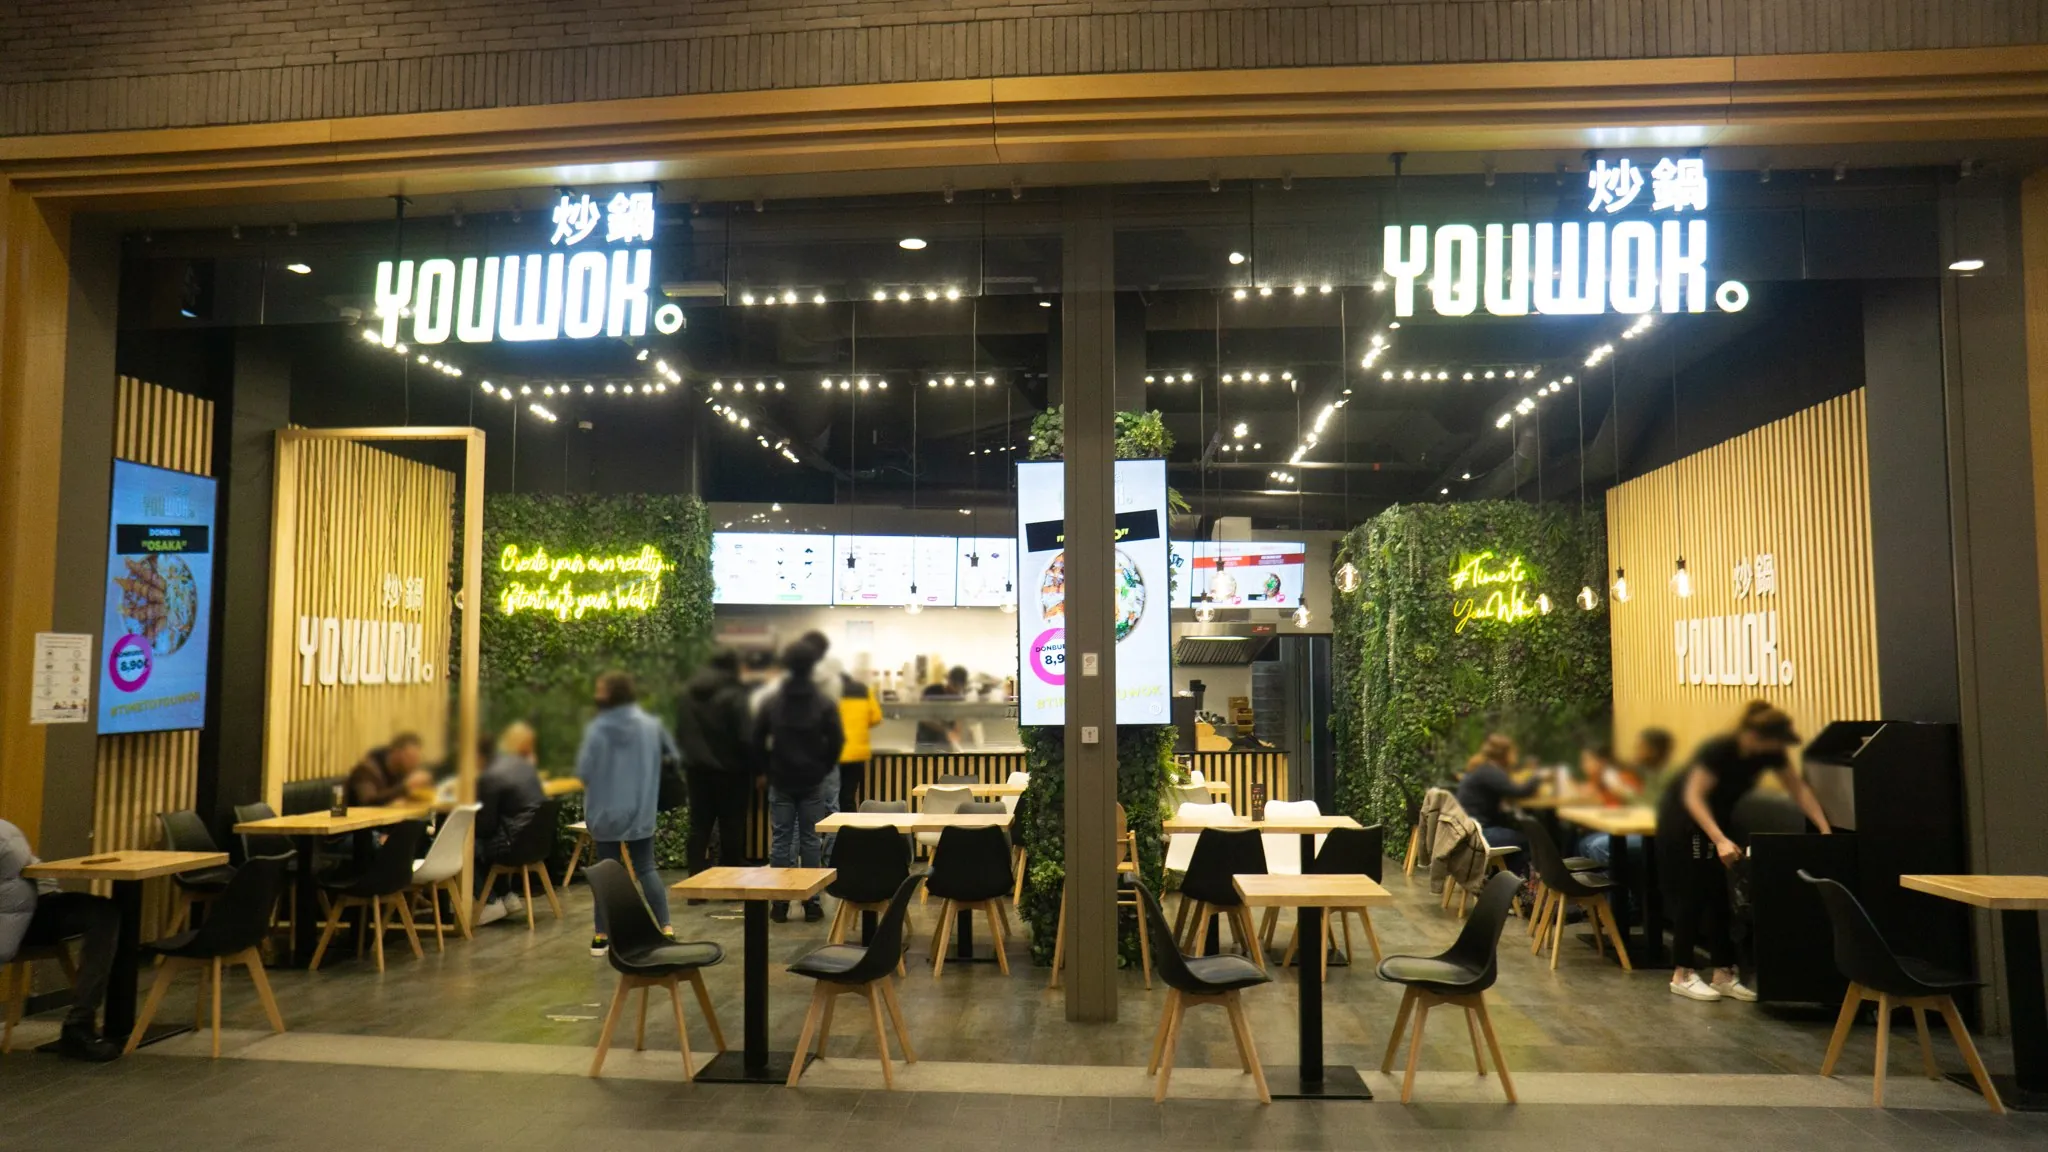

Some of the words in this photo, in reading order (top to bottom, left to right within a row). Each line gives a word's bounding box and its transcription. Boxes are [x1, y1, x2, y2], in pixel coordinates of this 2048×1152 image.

[1588, 158, 1707, 213] 炒鍋
[551, 192, 655, 245] 炒鍋
[501, 544, 549, 572] Create
[548, 554, 585, 582] your
[588, 556, 615, 573] own
[573, 591, 612, 619] your
[1045, 653, 1065, 666] 8,9
